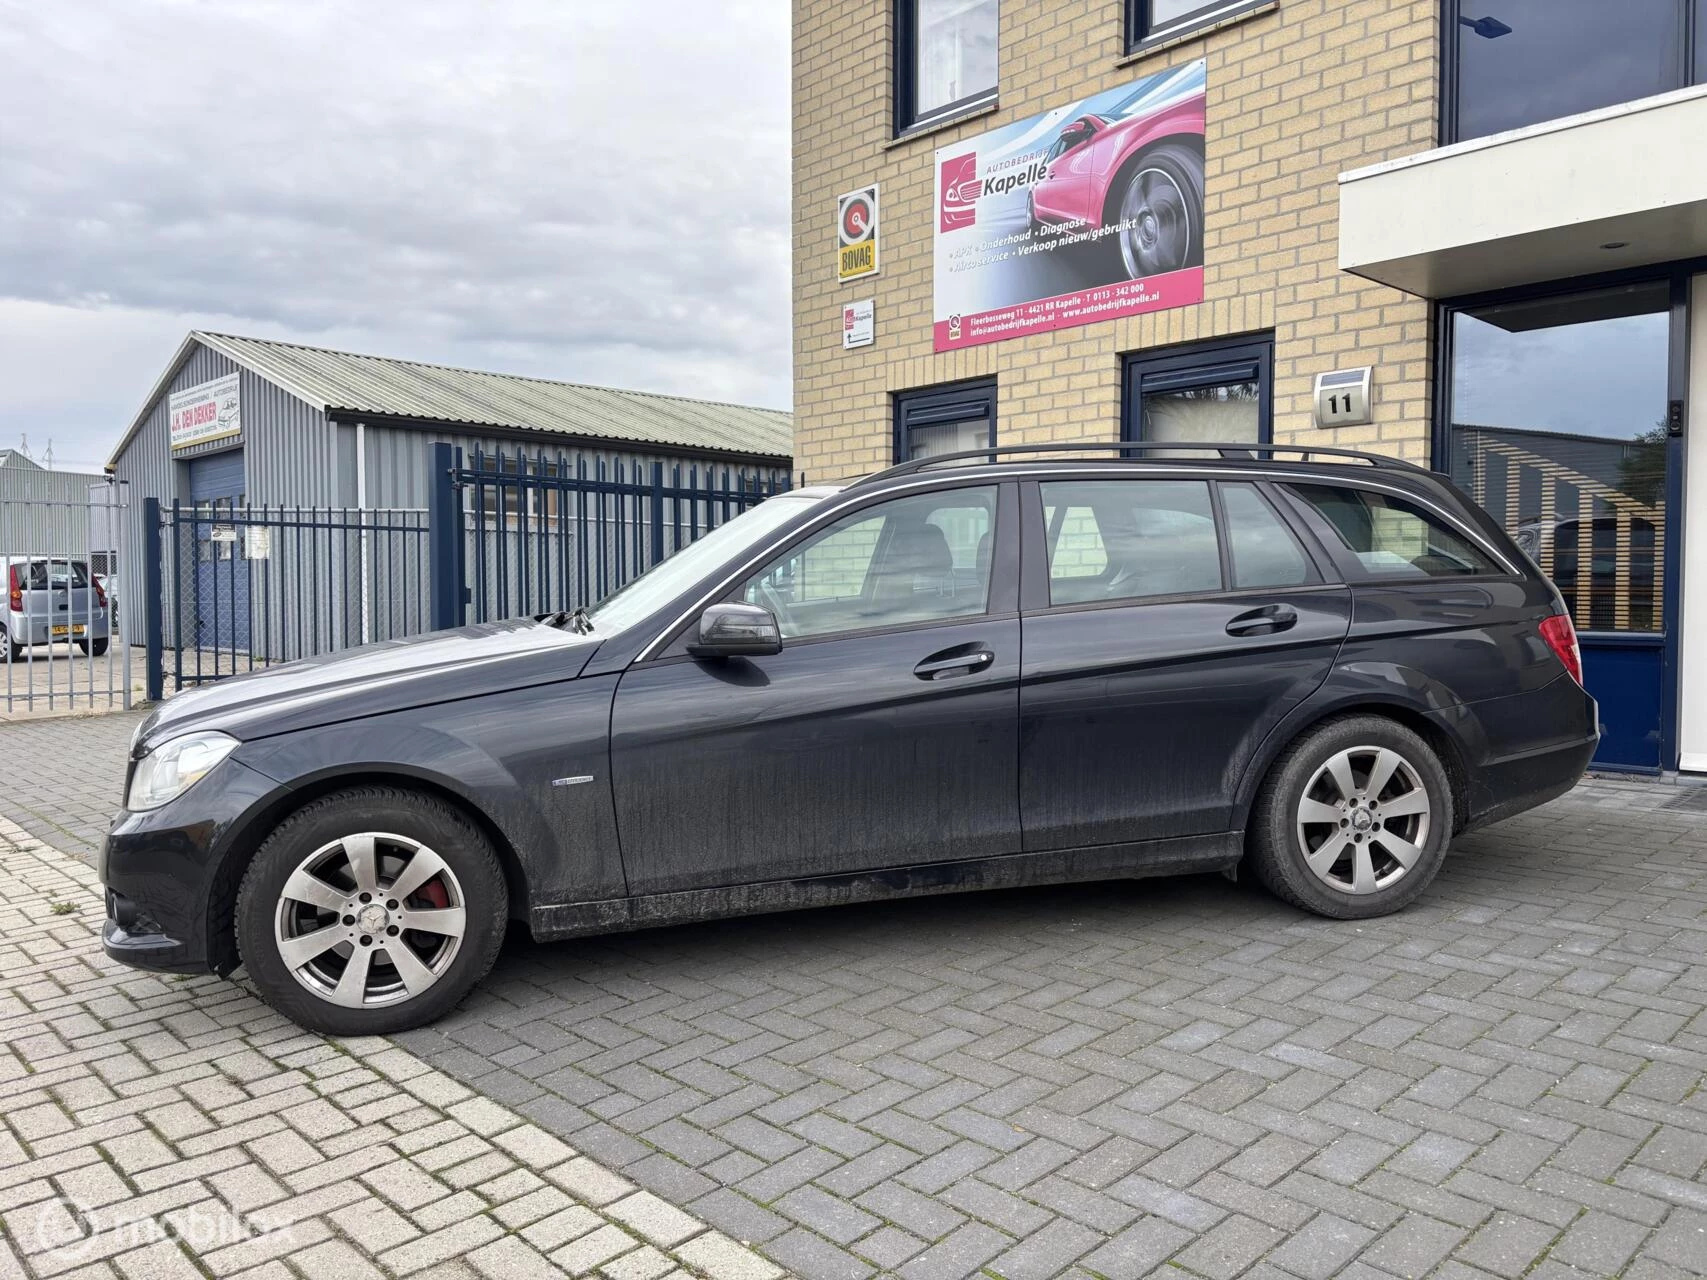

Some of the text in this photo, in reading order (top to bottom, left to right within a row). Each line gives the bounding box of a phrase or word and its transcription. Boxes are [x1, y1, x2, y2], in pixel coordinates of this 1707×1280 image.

[987, 147, 1049, 174] AUTOBEDRIJF
[984, 163, 1047, 196] Kapelle
[980, 228, 1032, 250] Onderhoud
[1040, 217, 1087, 236] Diagnose
[1018, 239, 1057, 257] Verkoop
[1058, 218, 1137, 246] nieuw/gebruikt
[842, 245, 871, 272] BOVAG
[970, 311, 1015, 326] Fleerbosseweg
[1016, 308, 1024, 317] 11
[1028, 304, 1044, 314] 4421
[1055, 296, 1081, 310] Kapelle
[1086, 294, 1091, 302] T
[1093, 290, 1110, 301] 0113
[1116, 286, 1129, 297] 342
[1130, 283, 1144, 293] 000
[970, 291, 1160, 336] info@autobedrijfkapelle.nl www.autobedrijfkapelle.nl
[182, 409, 193, 429] DEN
[194, 401, 217, 425] DEKKER
[1328, 393, 1351, 414] 11
